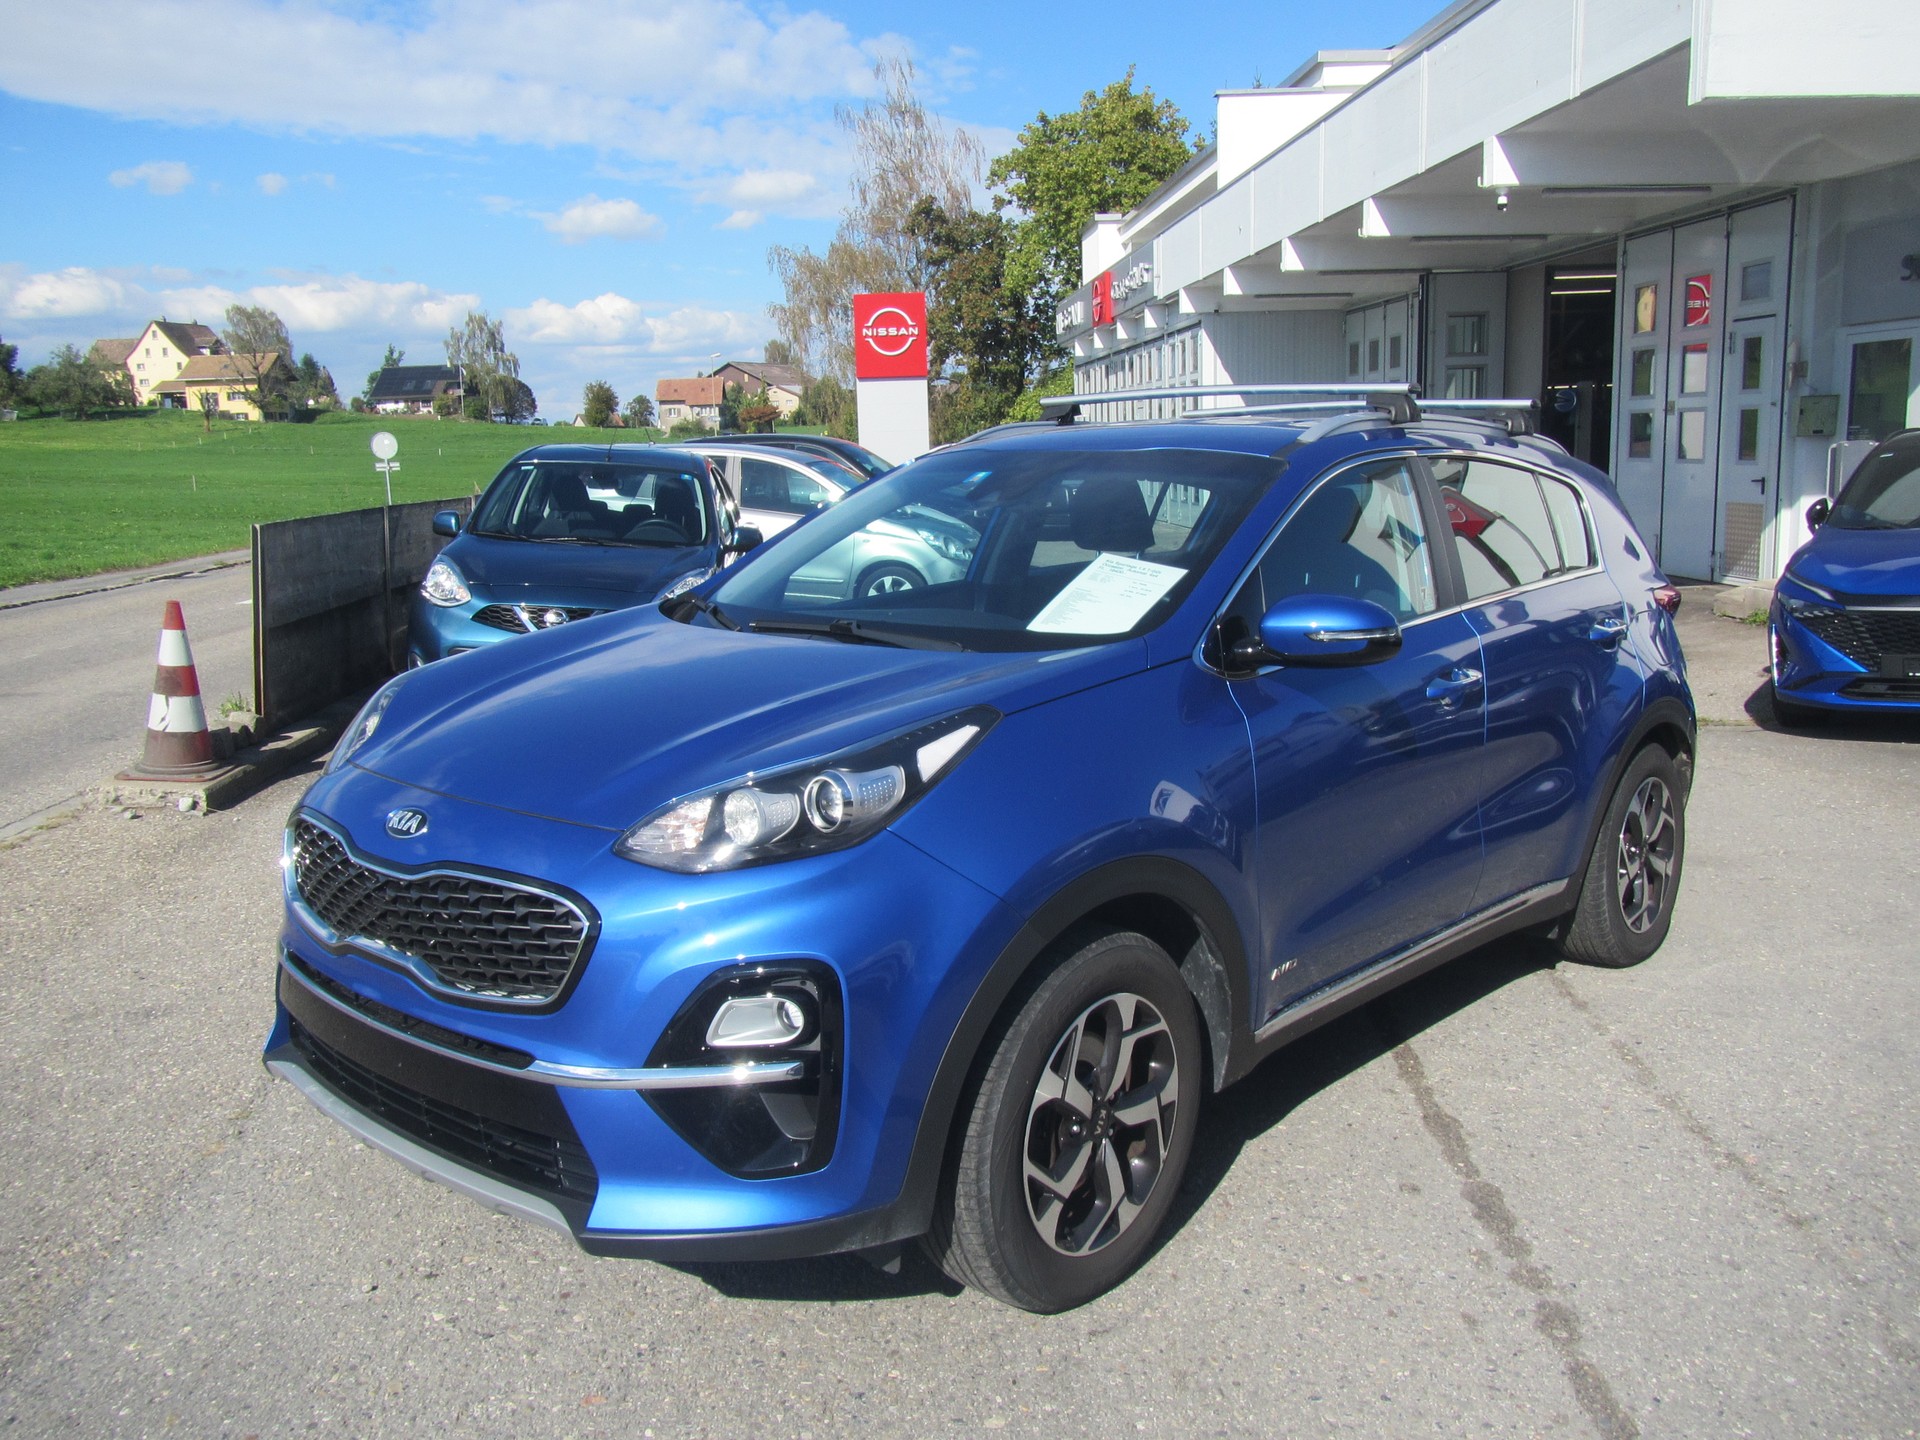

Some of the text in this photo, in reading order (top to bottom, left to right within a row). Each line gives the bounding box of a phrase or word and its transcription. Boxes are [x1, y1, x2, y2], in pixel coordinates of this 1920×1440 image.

[862, 326, 919, 336] NISSAN
[388, 810, 423, 834] KIA
[1094, 1109, 1107, 1135] KIA
